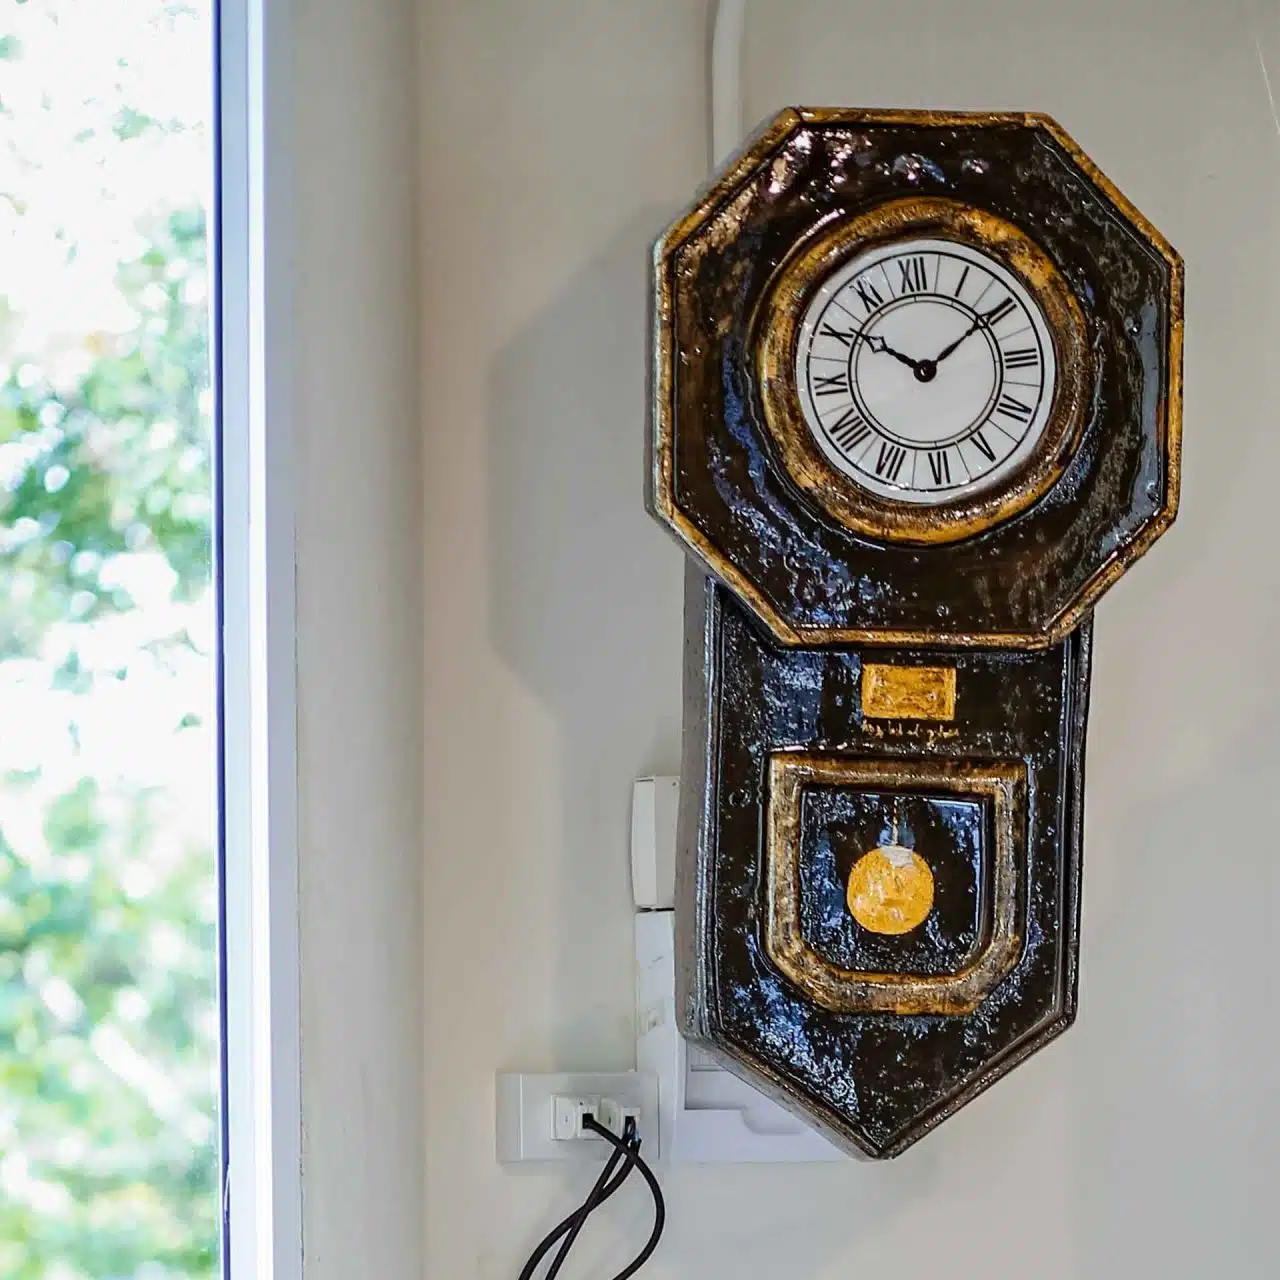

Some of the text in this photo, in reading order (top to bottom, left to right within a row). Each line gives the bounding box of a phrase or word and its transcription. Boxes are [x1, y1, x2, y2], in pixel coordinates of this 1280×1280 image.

[898, 257, 928, 293] XII
[955, 266, 969, 297] I
[819, 322, 855, 347] X
[1003, 348, 1039, 369] III
[813, 373, 848, 396] IX
[875, 442, 906, 481] VII
[970, 431, 996, 462] V
[928, 451, 951, 484] VI
